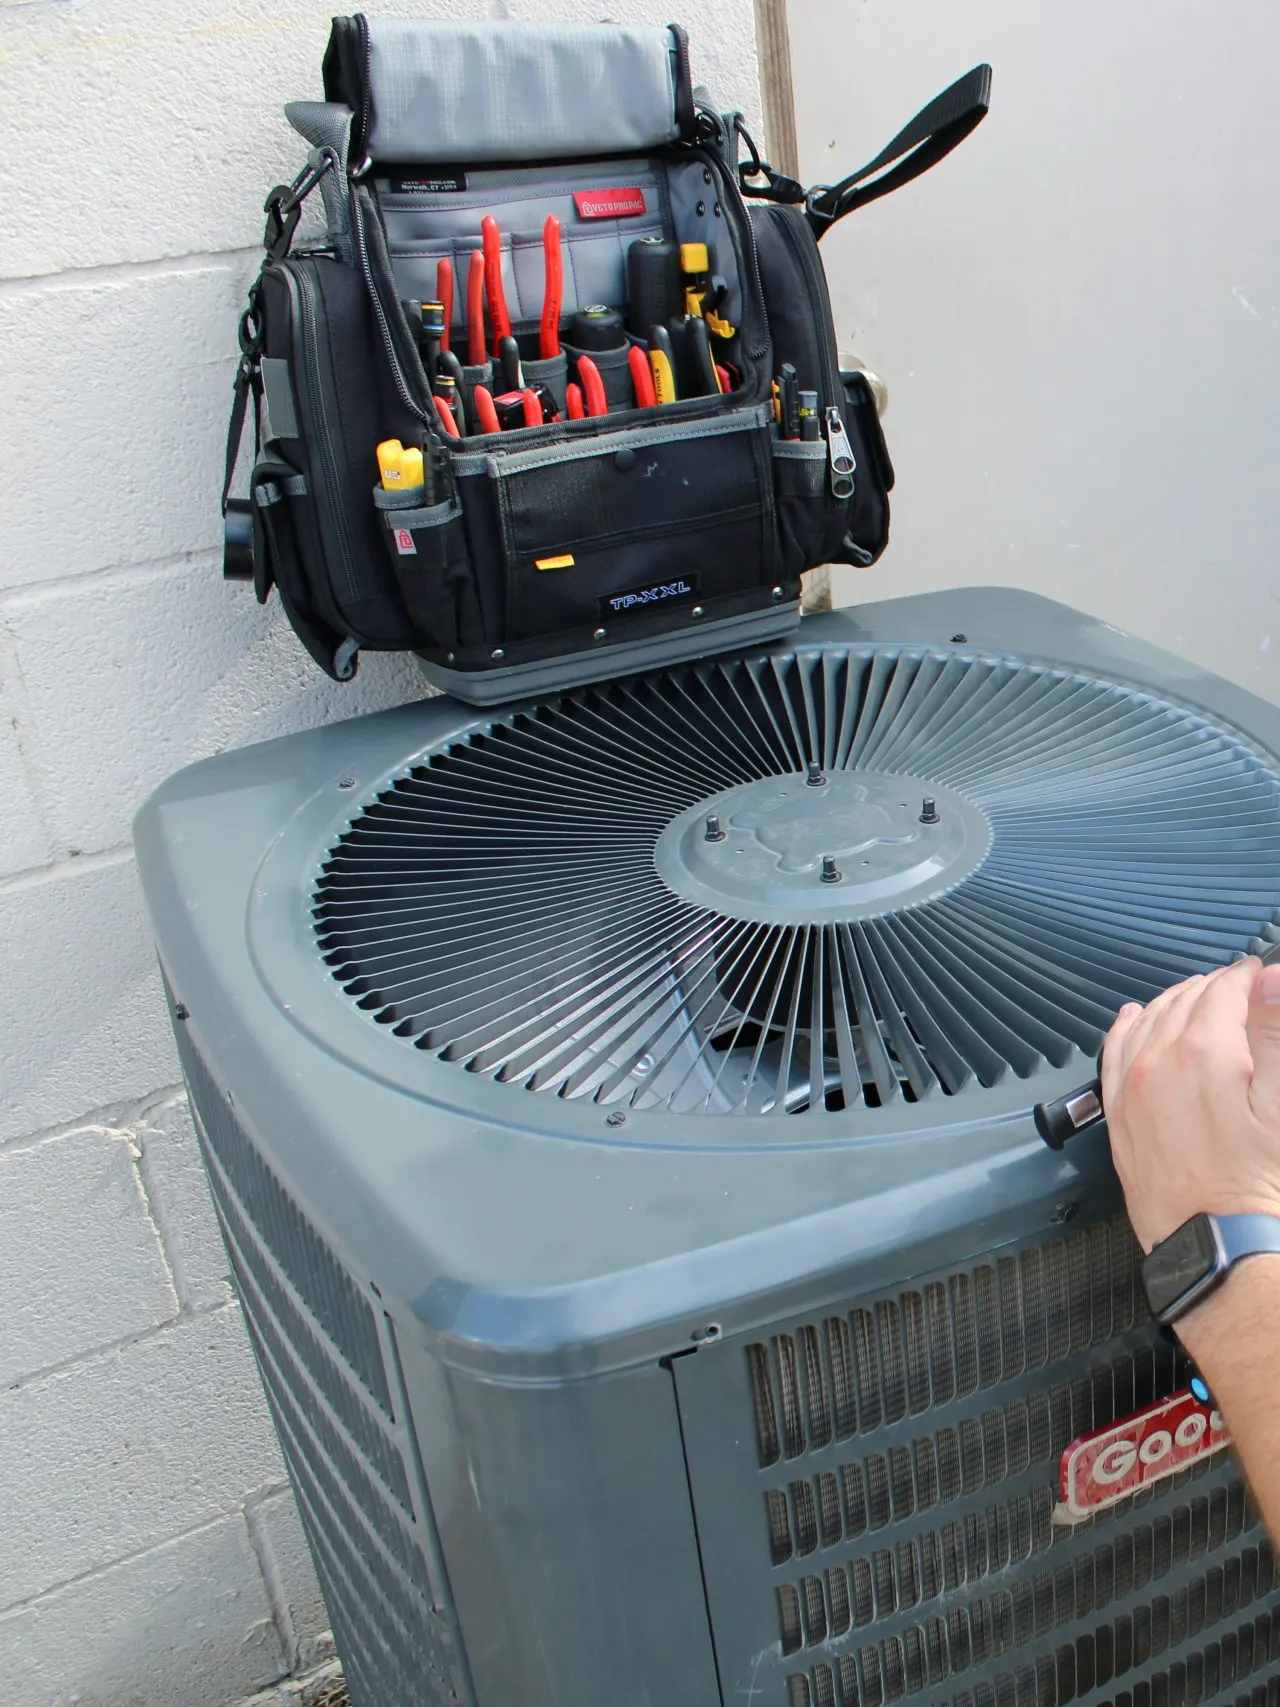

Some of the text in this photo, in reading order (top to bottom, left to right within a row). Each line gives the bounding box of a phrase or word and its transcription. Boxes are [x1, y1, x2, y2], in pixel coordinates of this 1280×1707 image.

[592, 200, 643, 213] VETO PRO PAC
[654, 367, 662, 397] TOOLS
